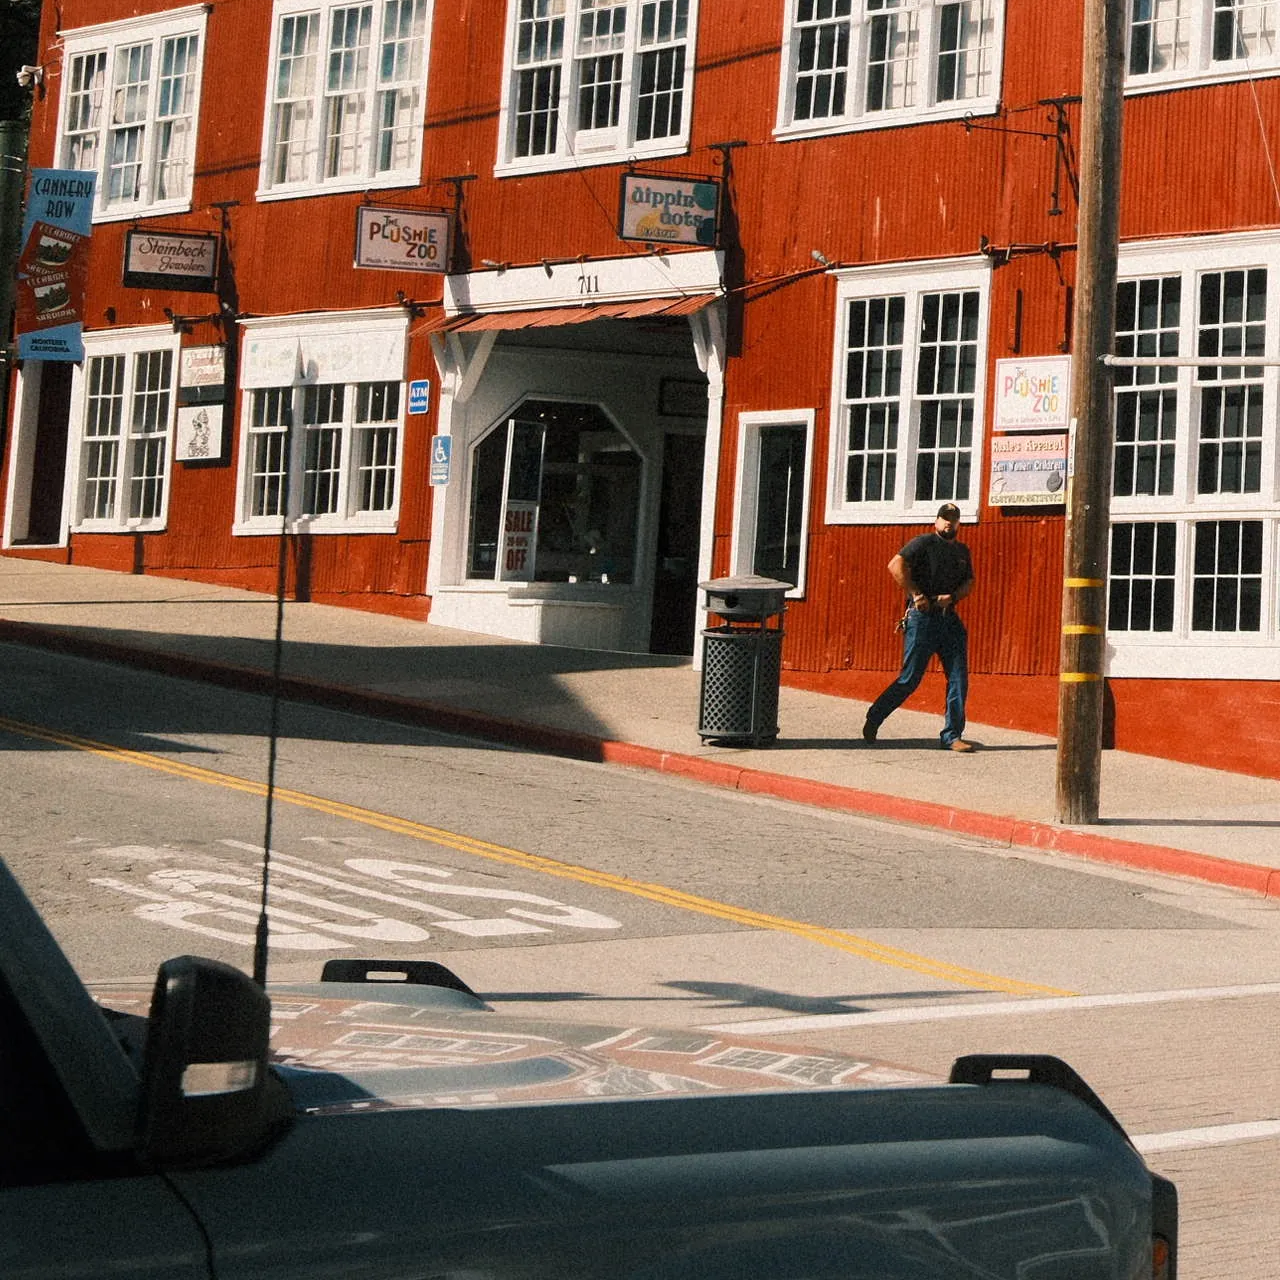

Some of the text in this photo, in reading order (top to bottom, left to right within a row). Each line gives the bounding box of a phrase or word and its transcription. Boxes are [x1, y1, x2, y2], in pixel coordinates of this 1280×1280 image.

[35, 178, 92, 198] CANNERY
[46, 200, 75, 218] ROW
[660, 209, 703, 228] dots
[139, 238, 206, 258] Steinbeck
[406, 242, 437, 260] ZOO
[158, 256, 206, 272] Jewelers
[578, 275, 600, 294] 711
[29, 345, 70, 353] CALIFORNIA
[31, 339, 67, 347] MONTEREY
[411, 387, 427, 398] ATM
[1032, 394, 1058, 413] ZOO
[1026, 439, 1064, 452] Apparel
[505, 510, 532, 532] SALE
[506, 549, 527, 571] OFF
